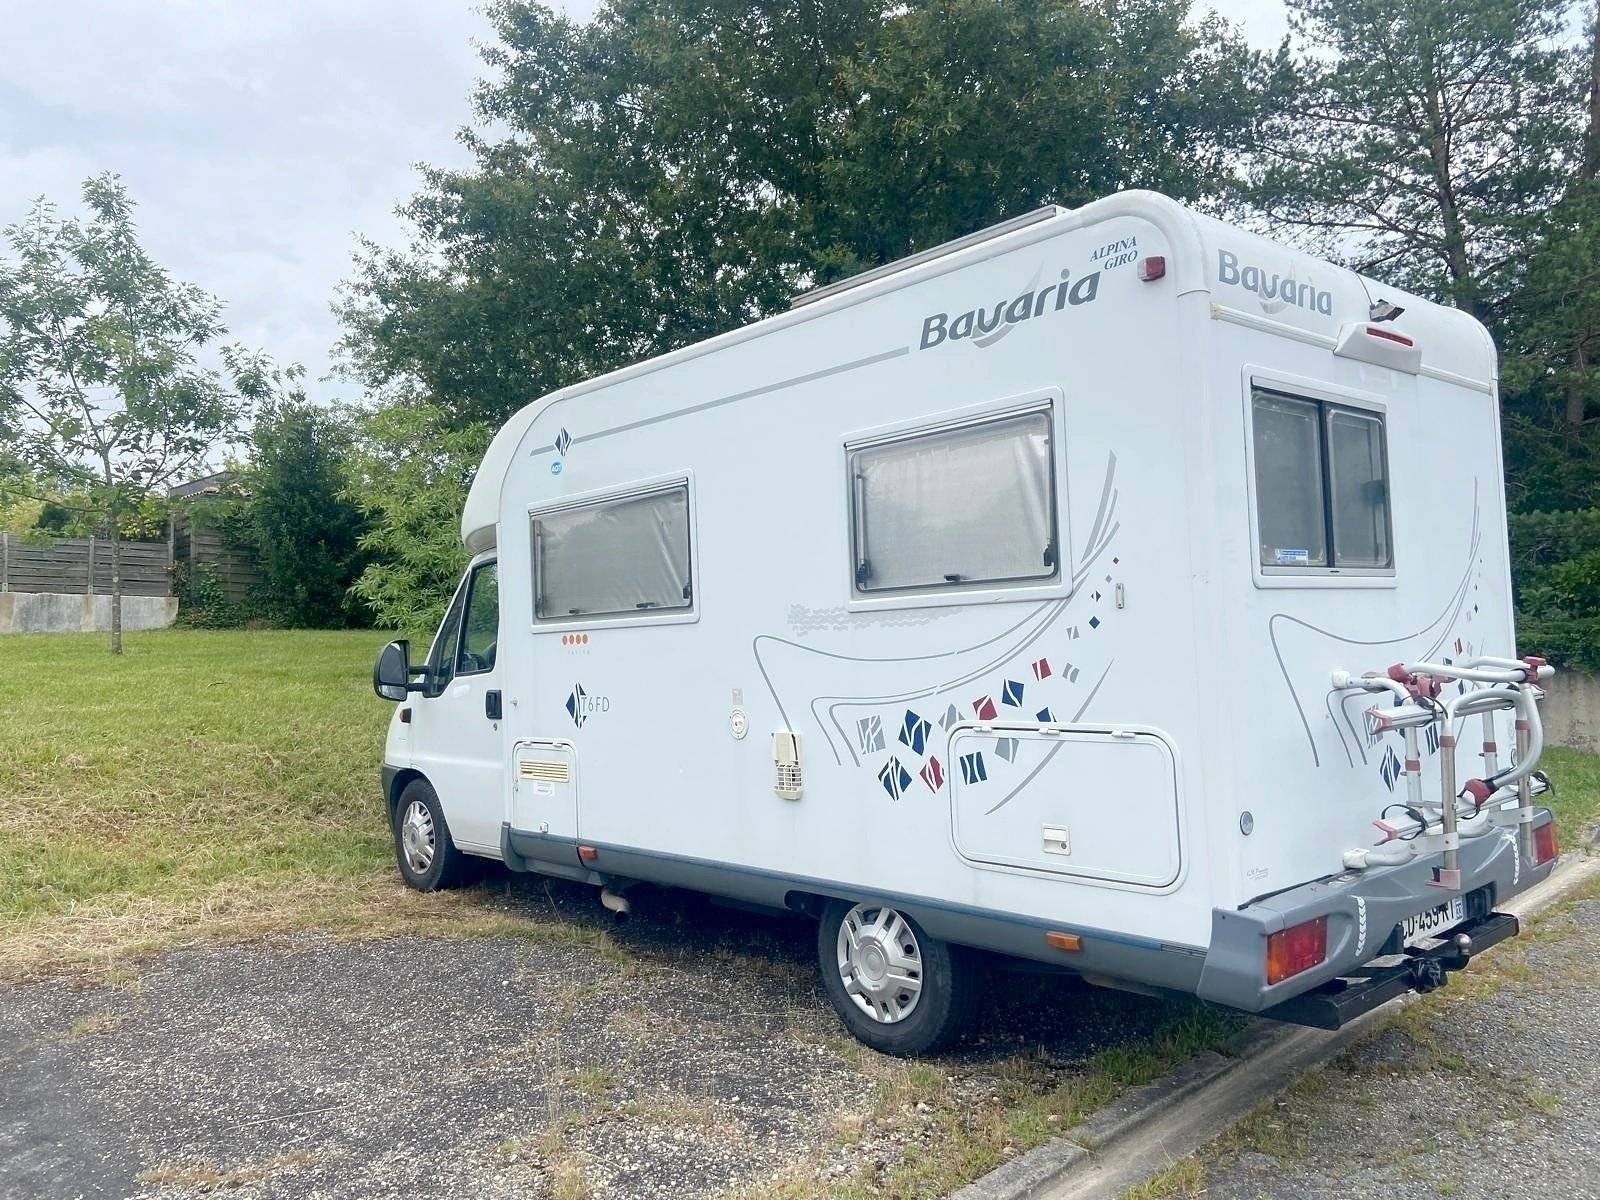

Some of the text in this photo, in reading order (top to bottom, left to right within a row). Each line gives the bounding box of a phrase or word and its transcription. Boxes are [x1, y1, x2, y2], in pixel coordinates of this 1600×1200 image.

[1090, 236, 1137, 262] ALPINA
[1104, 250, 1138, 270] GIRO
[1218, 248, 1332, 316] Bavaria
[920, 268, 1100, 350] Bavaria
[581, 697, 609, 712] T6FD
